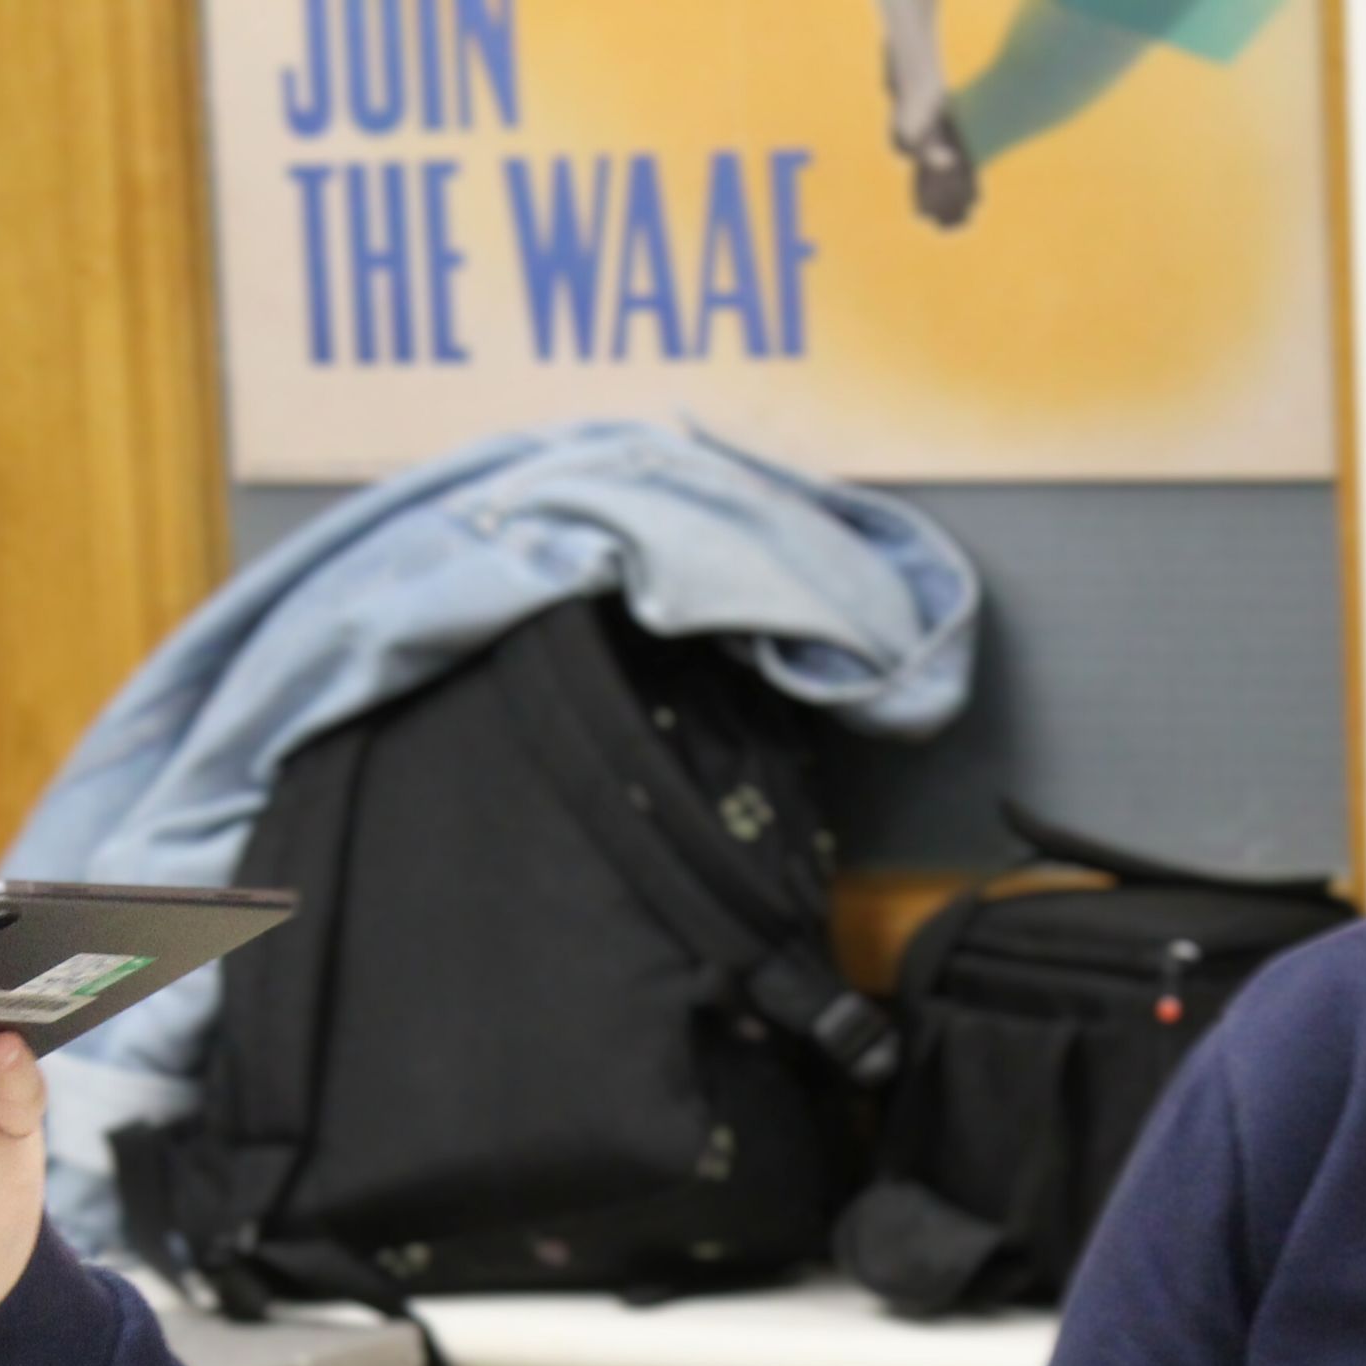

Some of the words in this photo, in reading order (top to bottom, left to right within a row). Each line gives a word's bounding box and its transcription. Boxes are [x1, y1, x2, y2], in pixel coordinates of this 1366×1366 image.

[281, 0, 520, 138] JOIN
[287, 160, 471, 366] THE
[501, 149, 819, 364] WAAF
